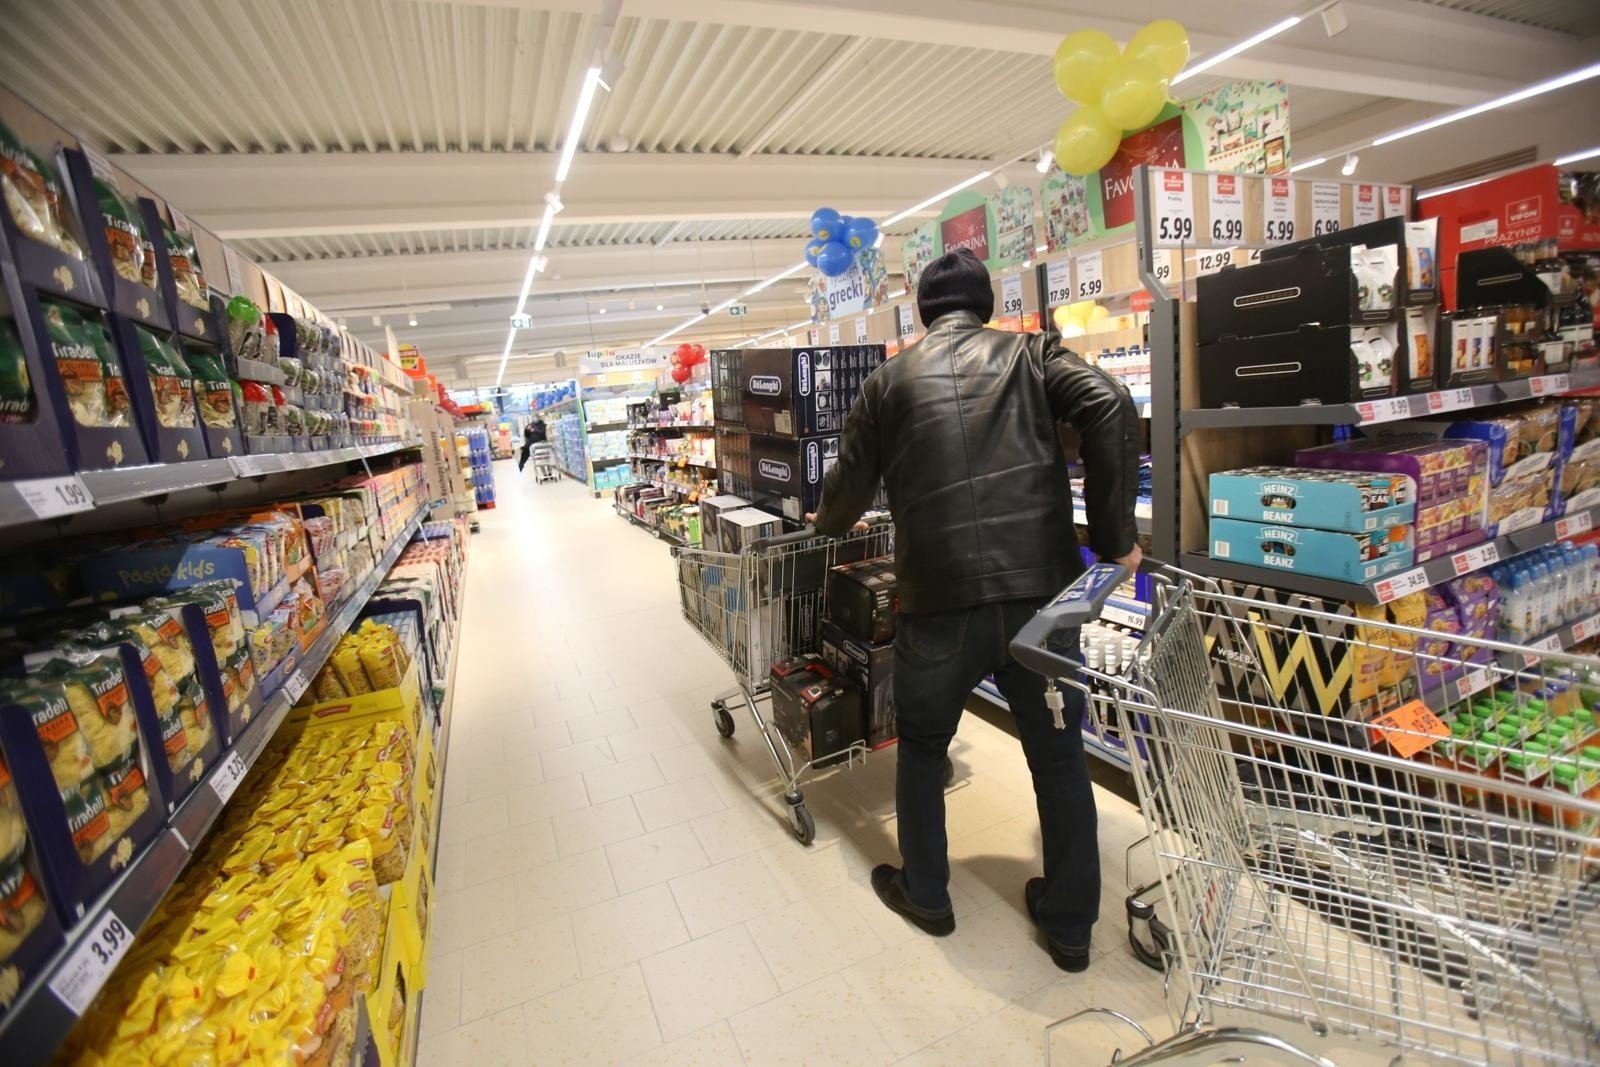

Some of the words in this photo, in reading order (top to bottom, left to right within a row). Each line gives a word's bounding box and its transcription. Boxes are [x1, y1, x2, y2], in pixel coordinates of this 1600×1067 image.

[1160, 217, 1192, 240] 5.99
[1213, 219, 1243, 240] 6.99
[1266, 220, 1294, 241] 5.99
[1199, 250, 1230, 271] 12.99
[829, 277, 864, 311] grecki
[1050, 287, 1070, 303] 17.99
[1079, 279, 1102, 298] 5.99
[1004, 298, 1022, 313] 5.99
[902, 323, 914, 336] 6.99
[752, 379, 779, 392] DeLonghi
[761, 462, 788, 478] DeLonghi
[809, 445, 817, 481] DeLonghi
[55, 484, 86, 506] 1.99
[1263, 483, 1294, 495] HEINZ
[1263, 510, 1294, 523] BEANZ
[1264, 529, 1295, 542] HEINZ
[176, 559, 216, 581] kids
[1263, 555, 1295, 569] BEANZ
[227, 755, 246, 781] 3.75
[91, 918, 126, 965] 3.99
